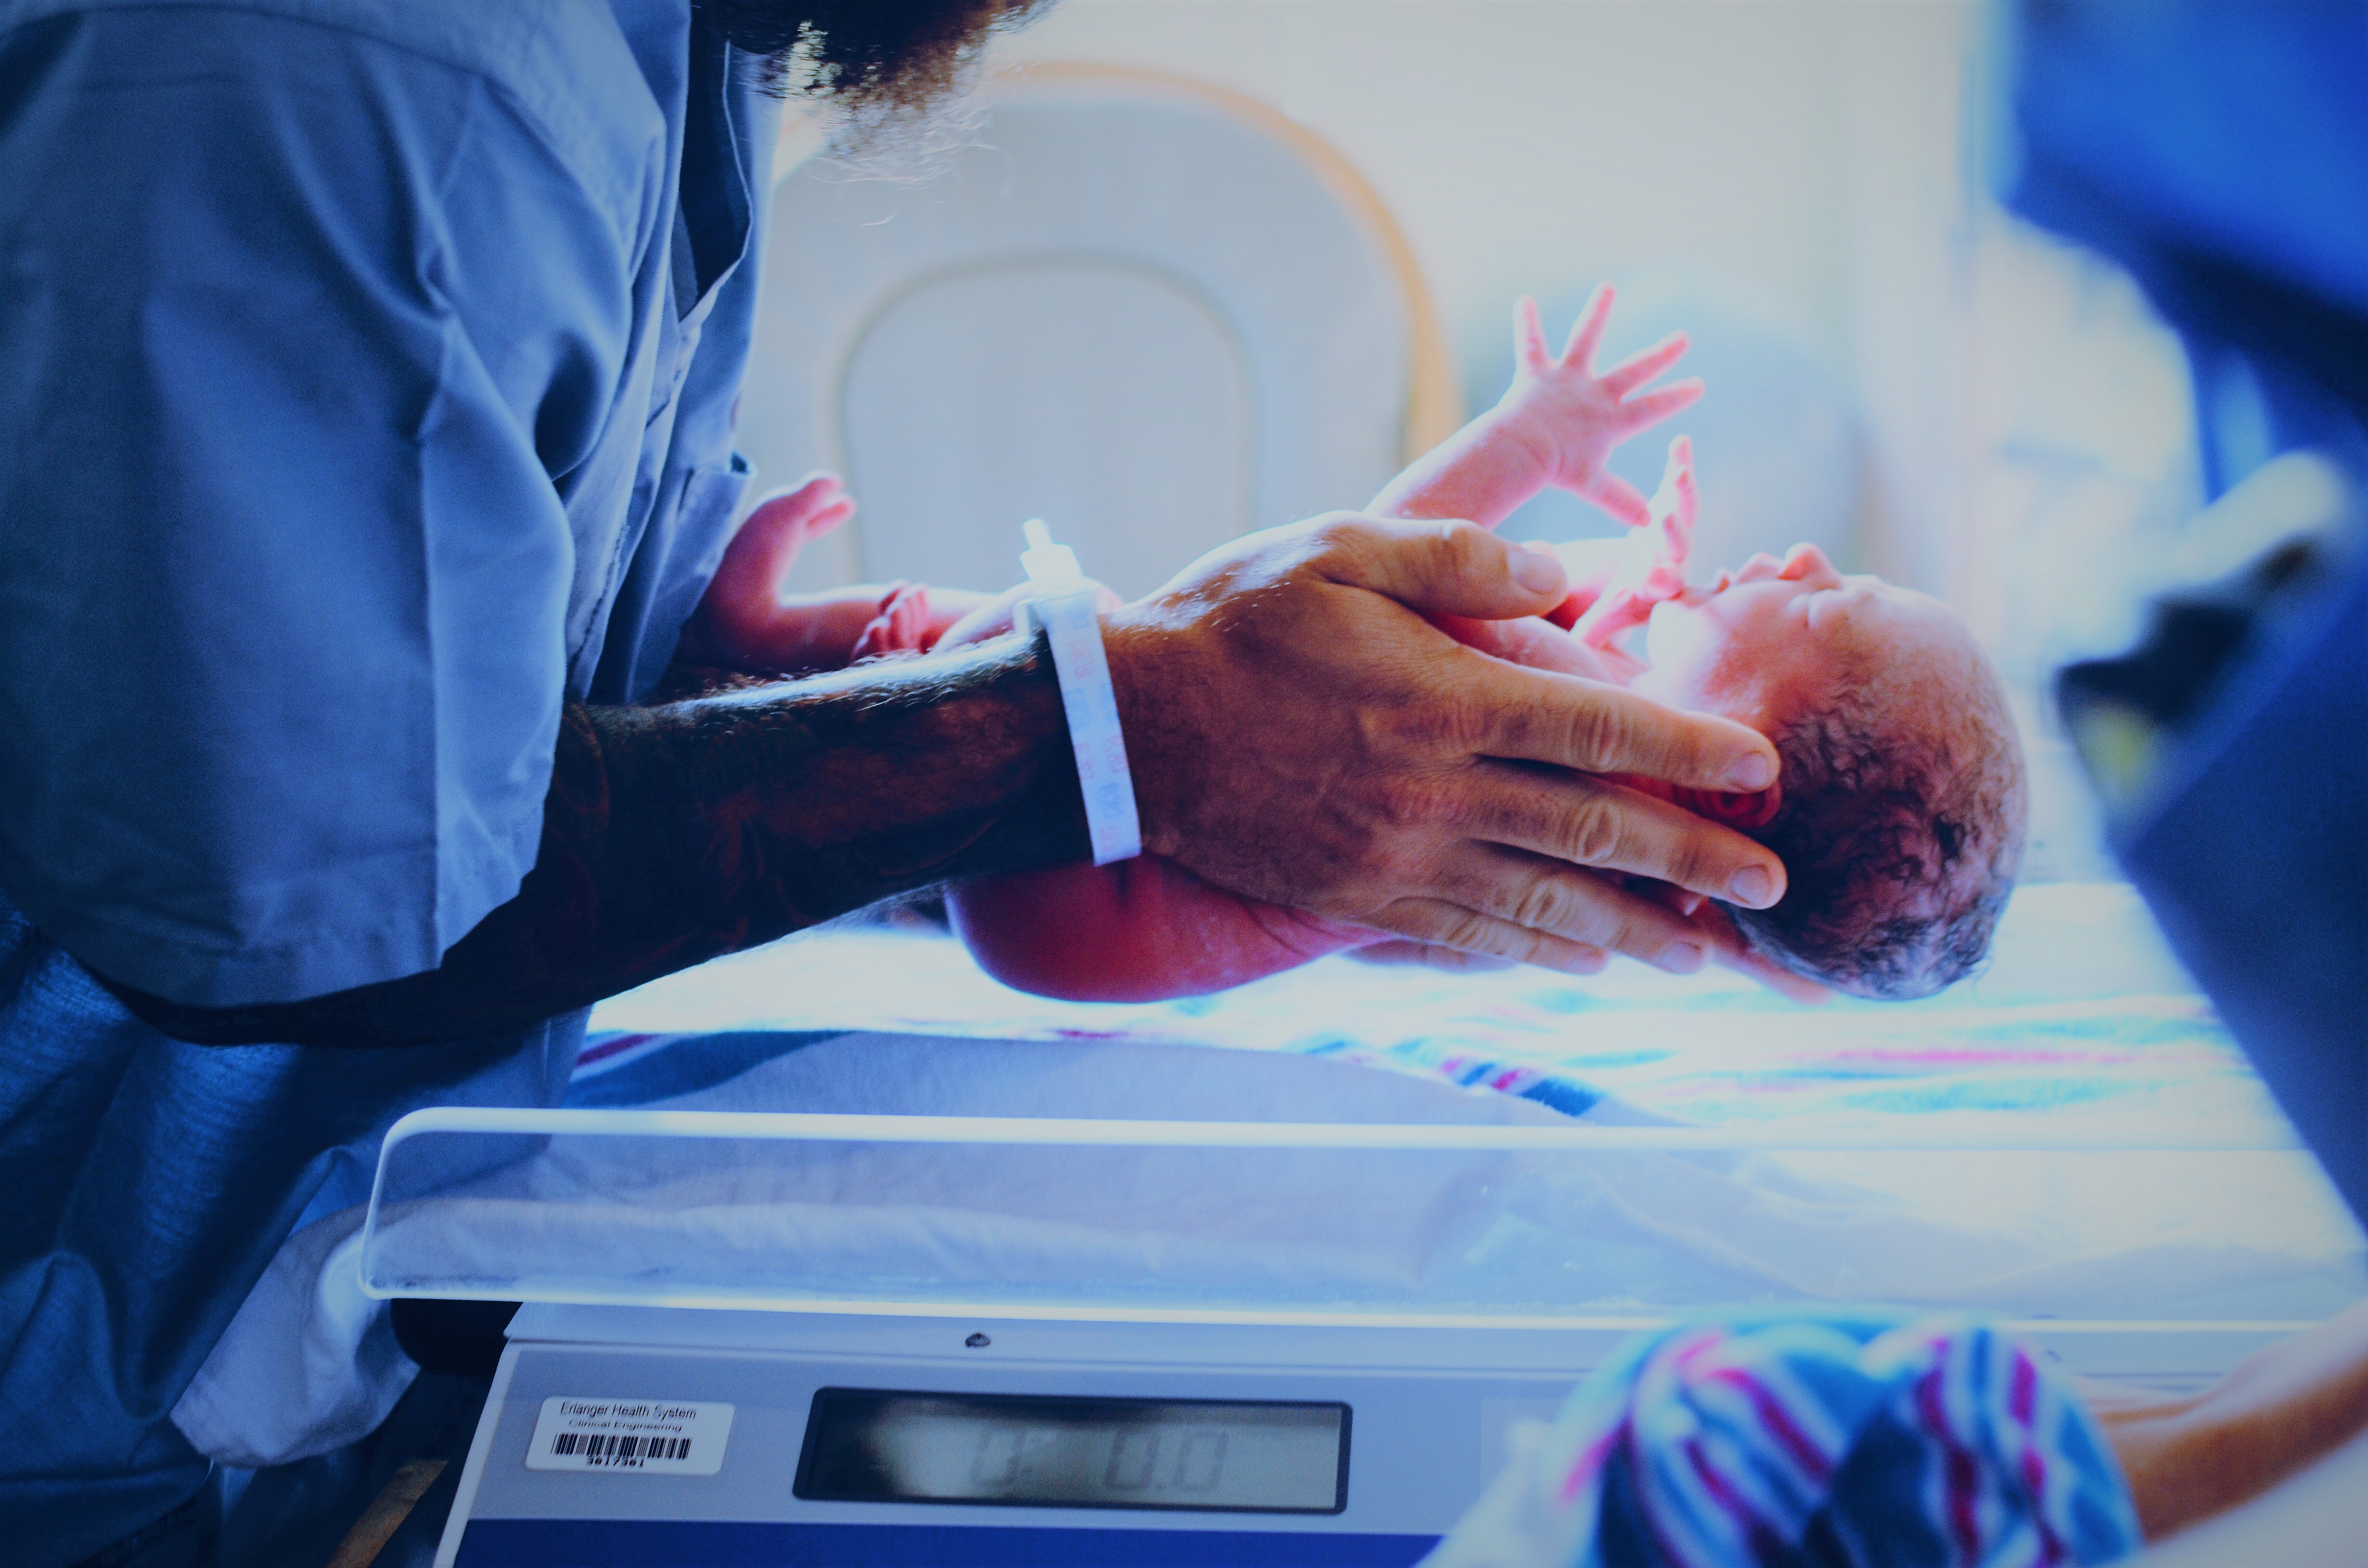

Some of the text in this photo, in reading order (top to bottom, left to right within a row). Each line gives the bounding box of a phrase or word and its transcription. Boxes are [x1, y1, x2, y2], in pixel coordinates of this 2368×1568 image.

[560, 1401, 697, 1422] Erlanger Health System
[568, 1419, 682, 1433] Clinical Engineering
